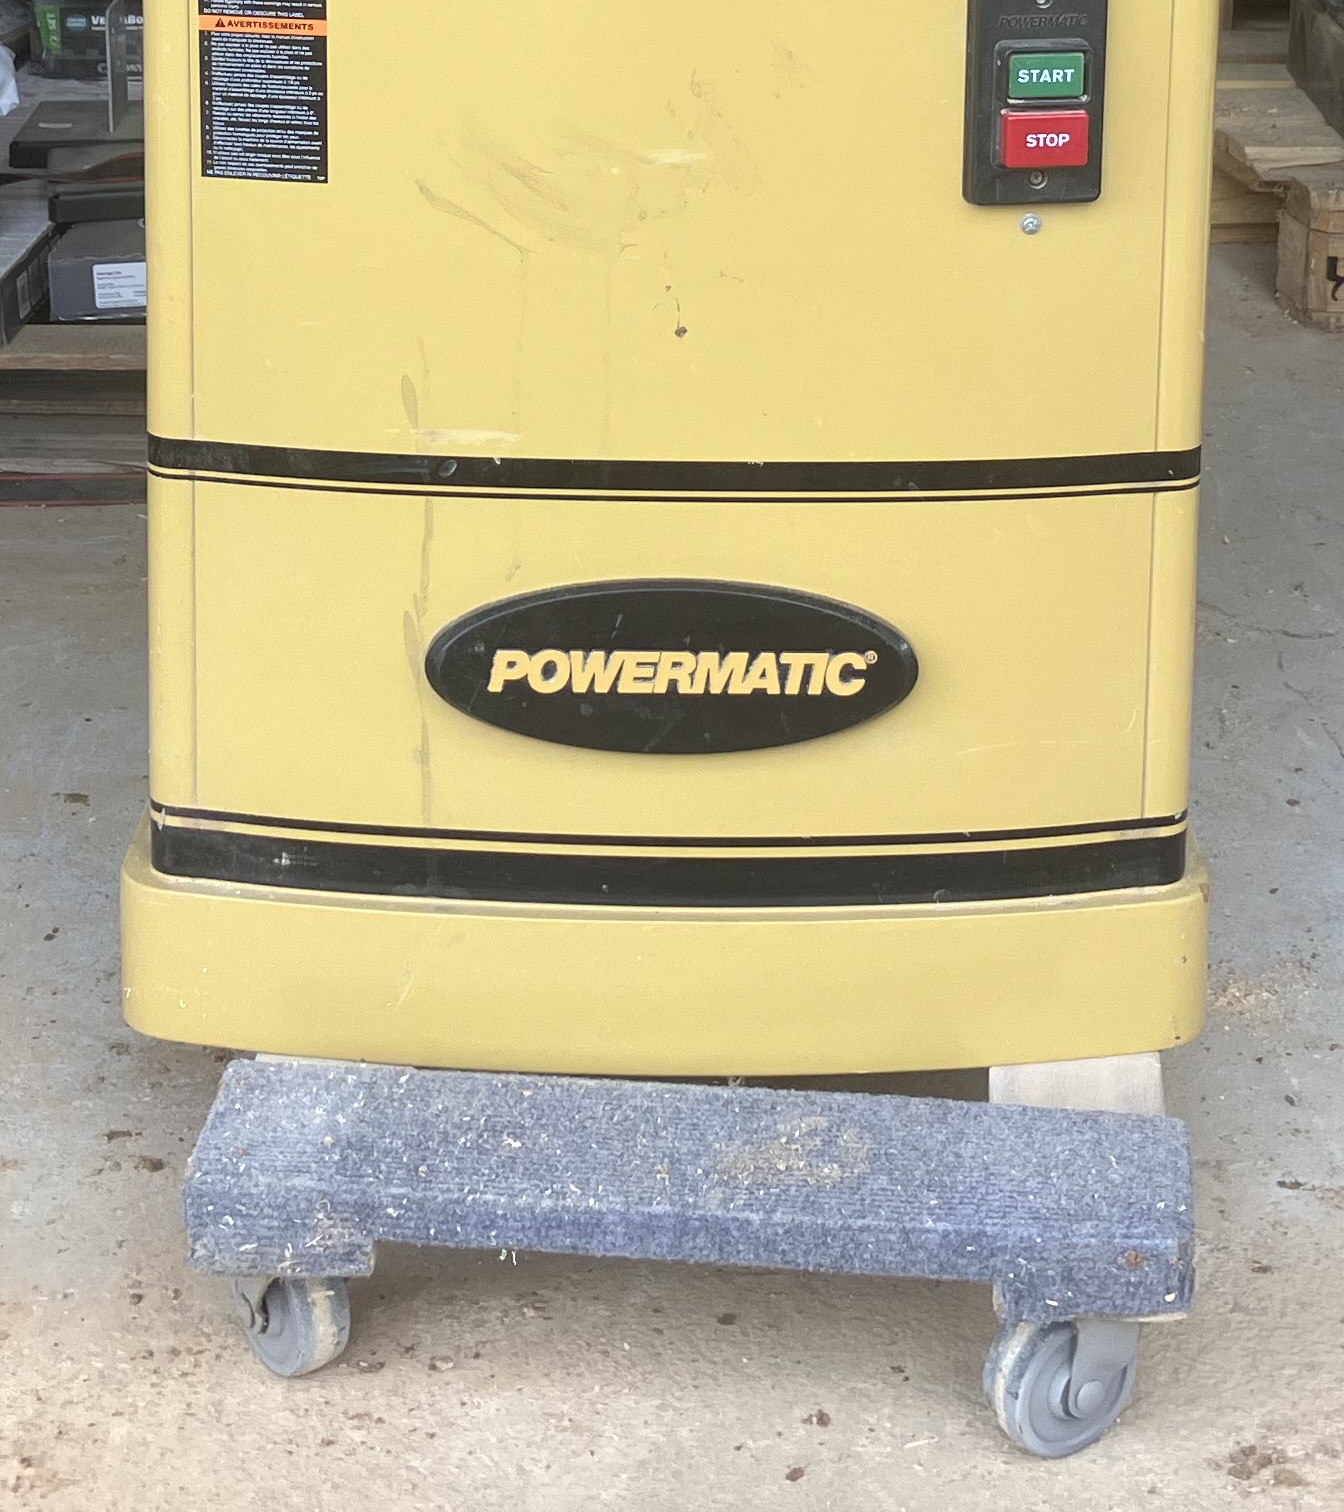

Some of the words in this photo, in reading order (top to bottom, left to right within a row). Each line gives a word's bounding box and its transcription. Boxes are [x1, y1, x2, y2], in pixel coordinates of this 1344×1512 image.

[226, 19, 314, 32] AVERTISSEMENTS
[997, 13, 1088, 29] POWERMATIC
[1017, 68, 1075, 83] START
[1025, 133, 1070, 148] STOP
[486, 648, 868, 696] POWERMATIC
